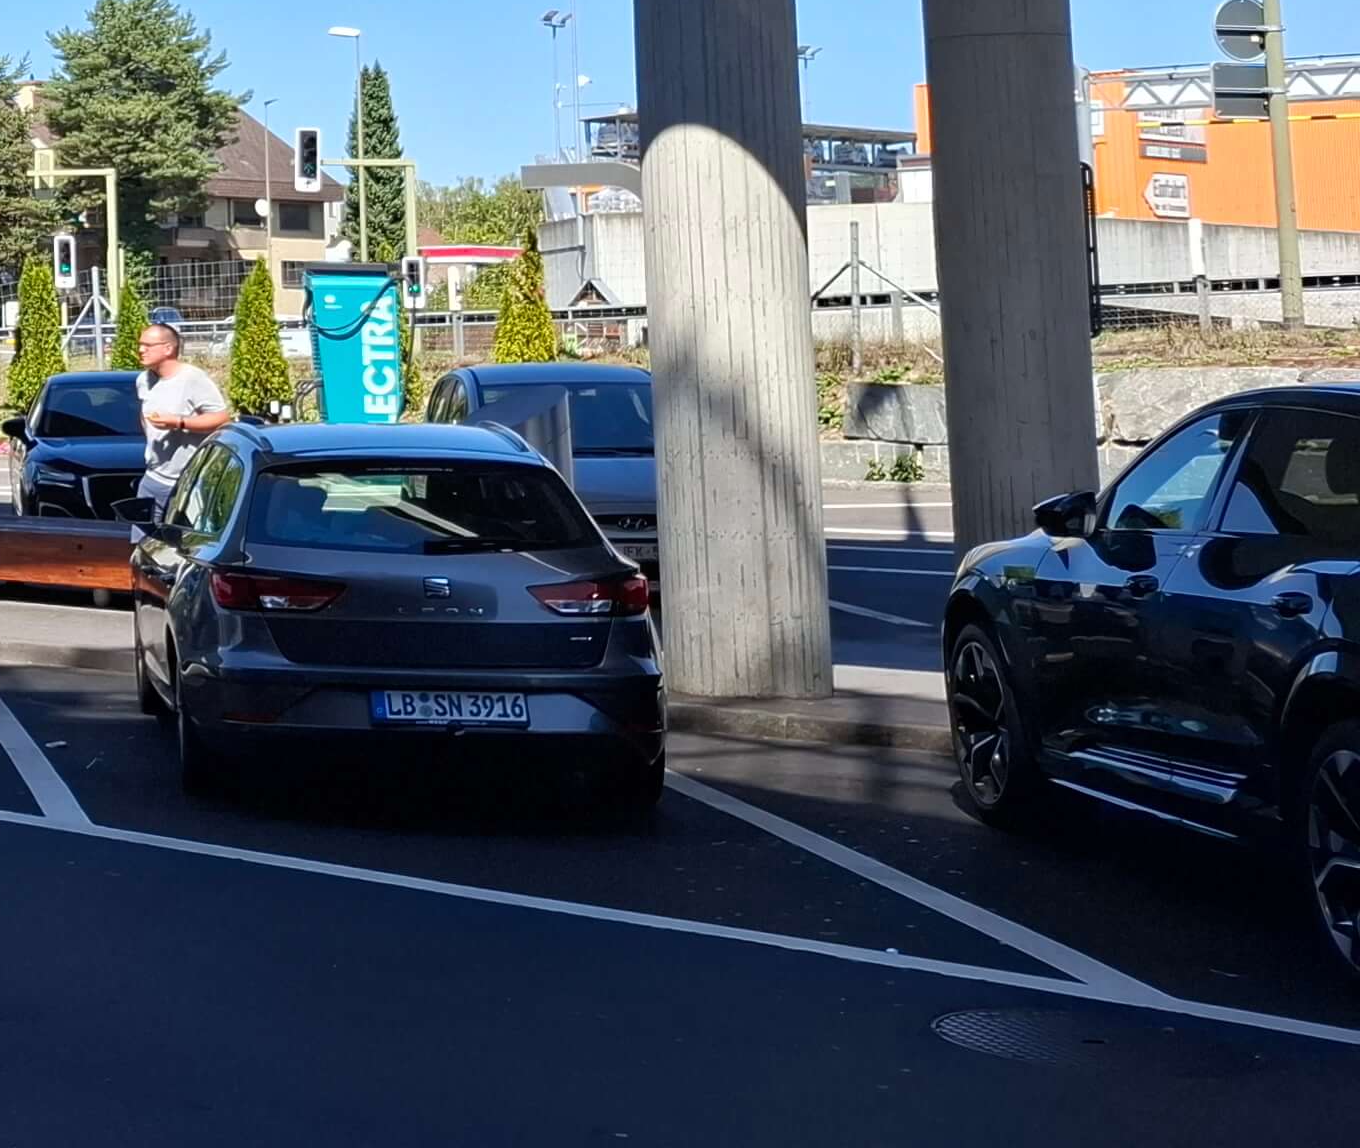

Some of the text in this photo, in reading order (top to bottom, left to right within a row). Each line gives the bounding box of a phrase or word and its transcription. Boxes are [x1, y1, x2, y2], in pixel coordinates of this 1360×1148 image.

[360, 295, 398, 424] LECTRA
[386, 692, 524, 719] LB SN 3916
